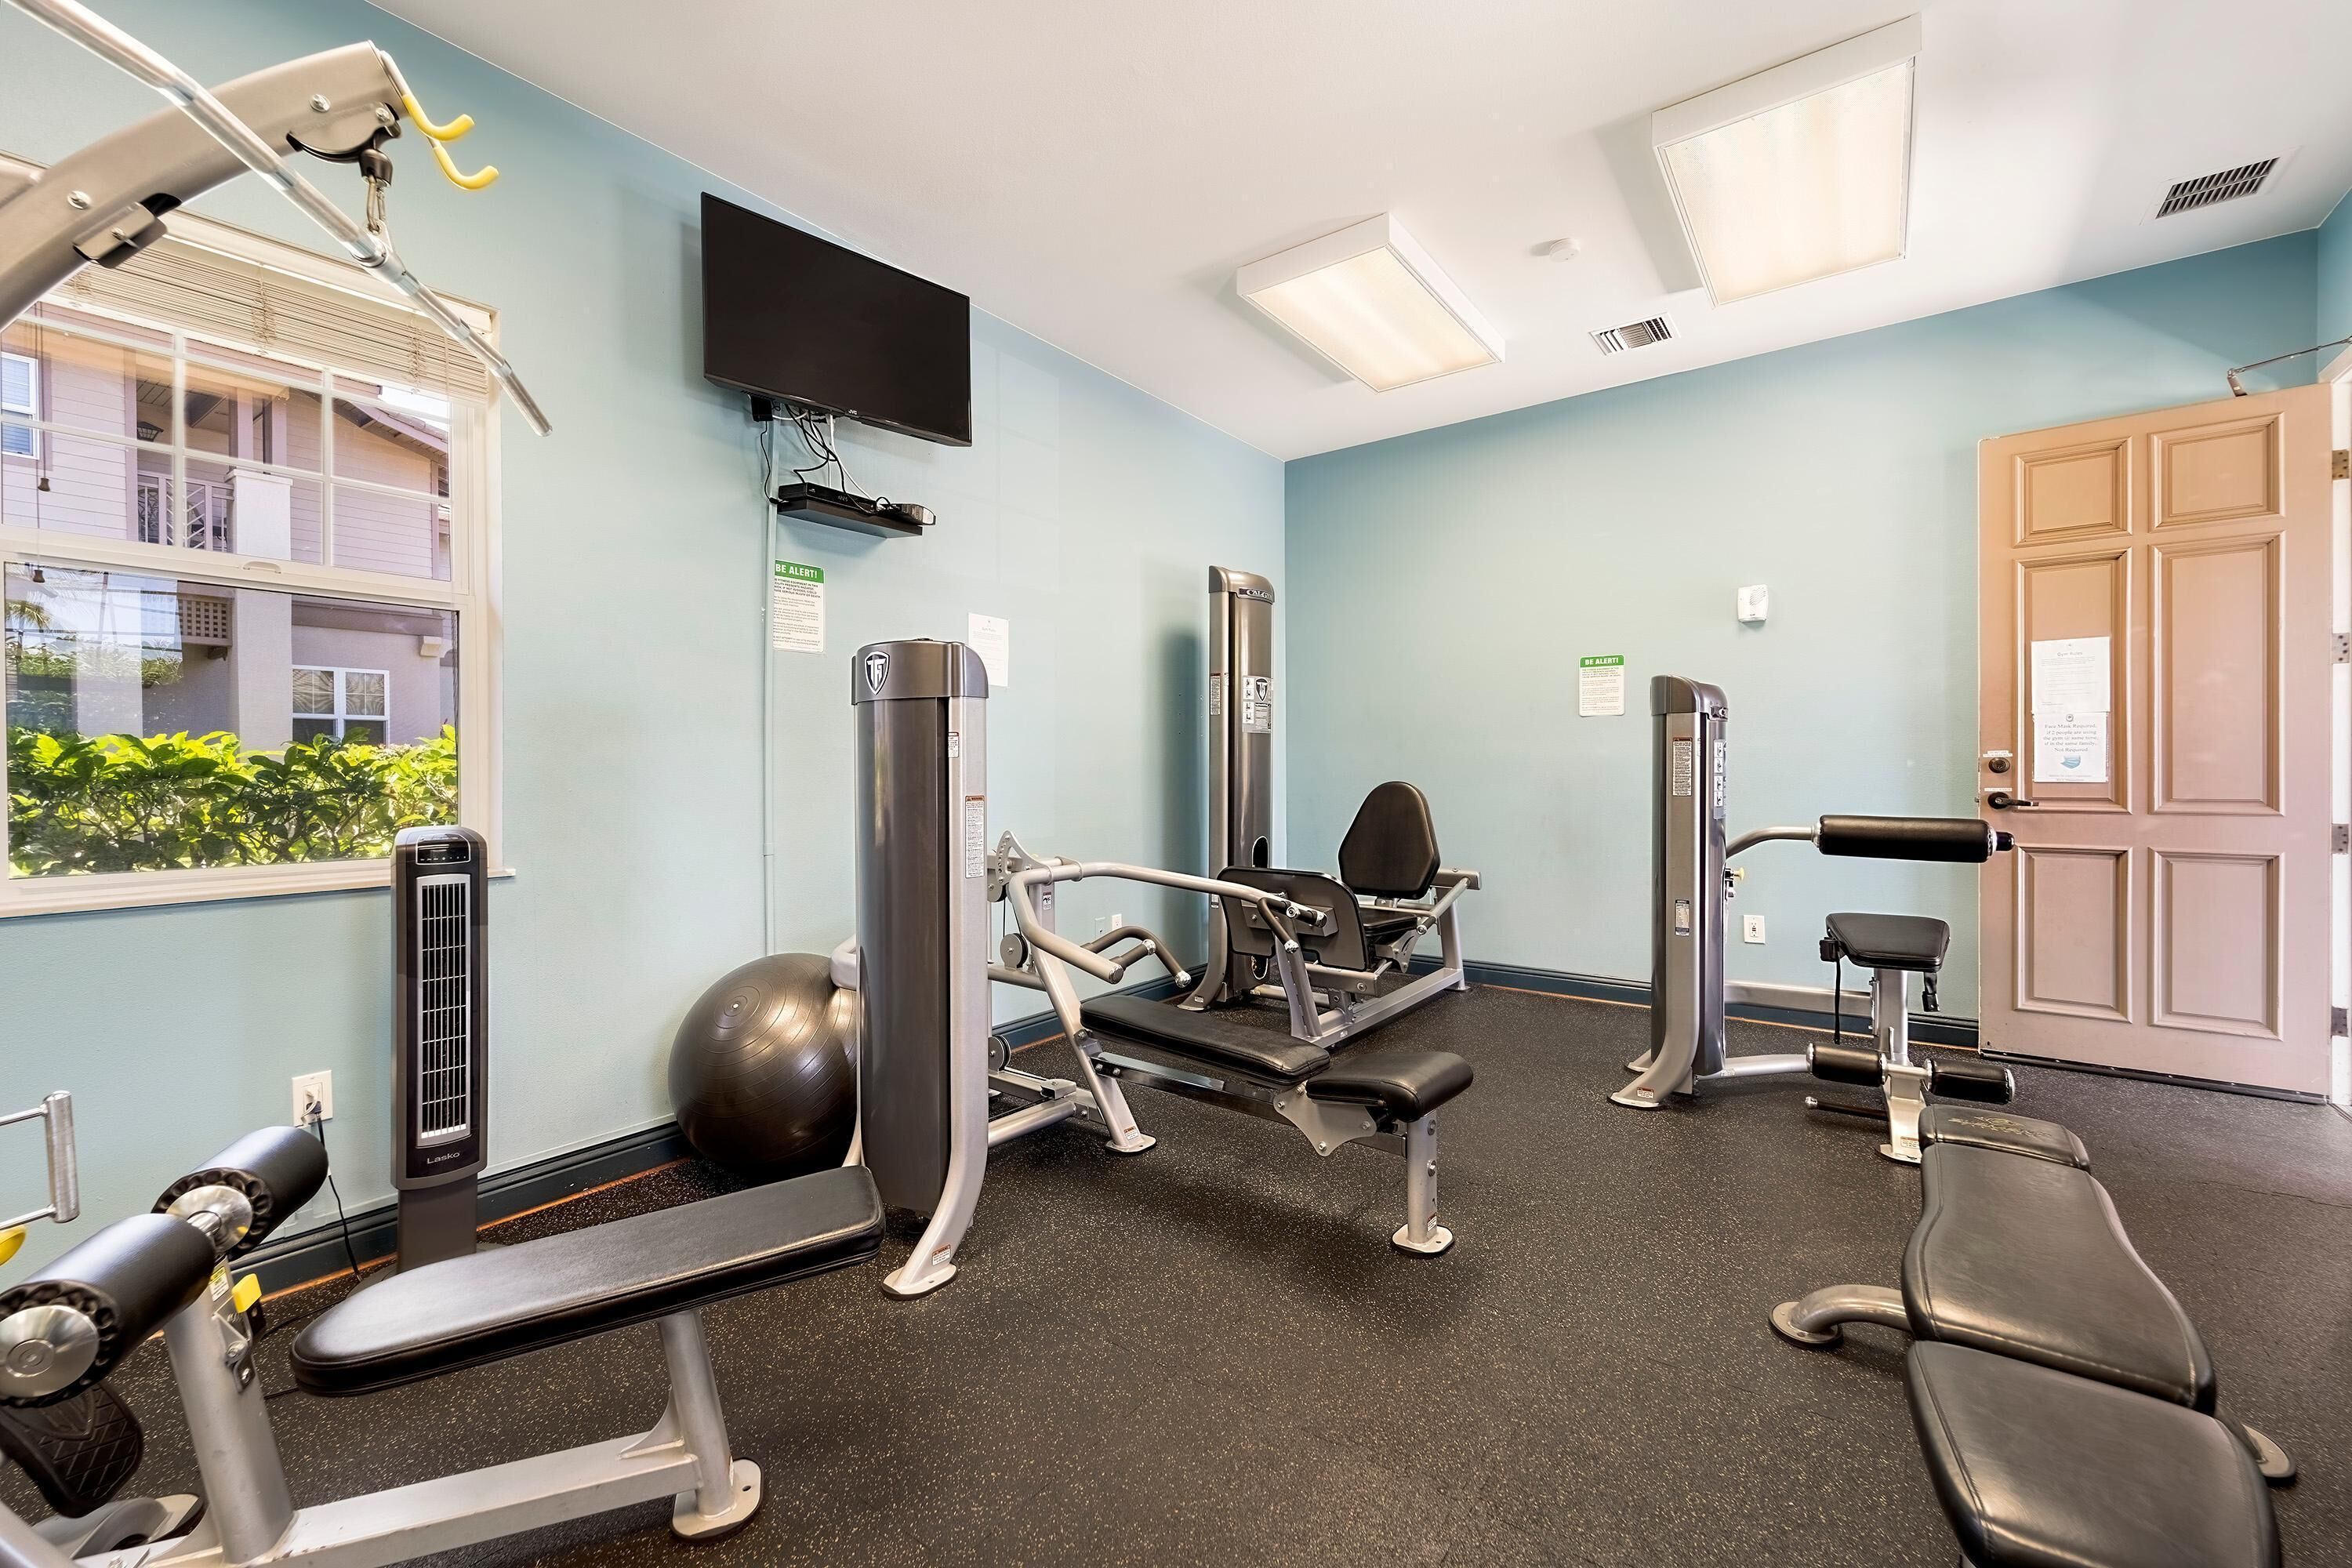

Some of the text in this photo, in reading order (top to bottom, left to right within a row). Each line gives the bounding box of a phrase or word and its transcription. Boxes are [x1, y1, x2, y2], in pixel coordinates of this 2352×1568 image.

[775, 564, 818, 579] BE ALERT!
[426, 1152, 460, 1164] Lasko
